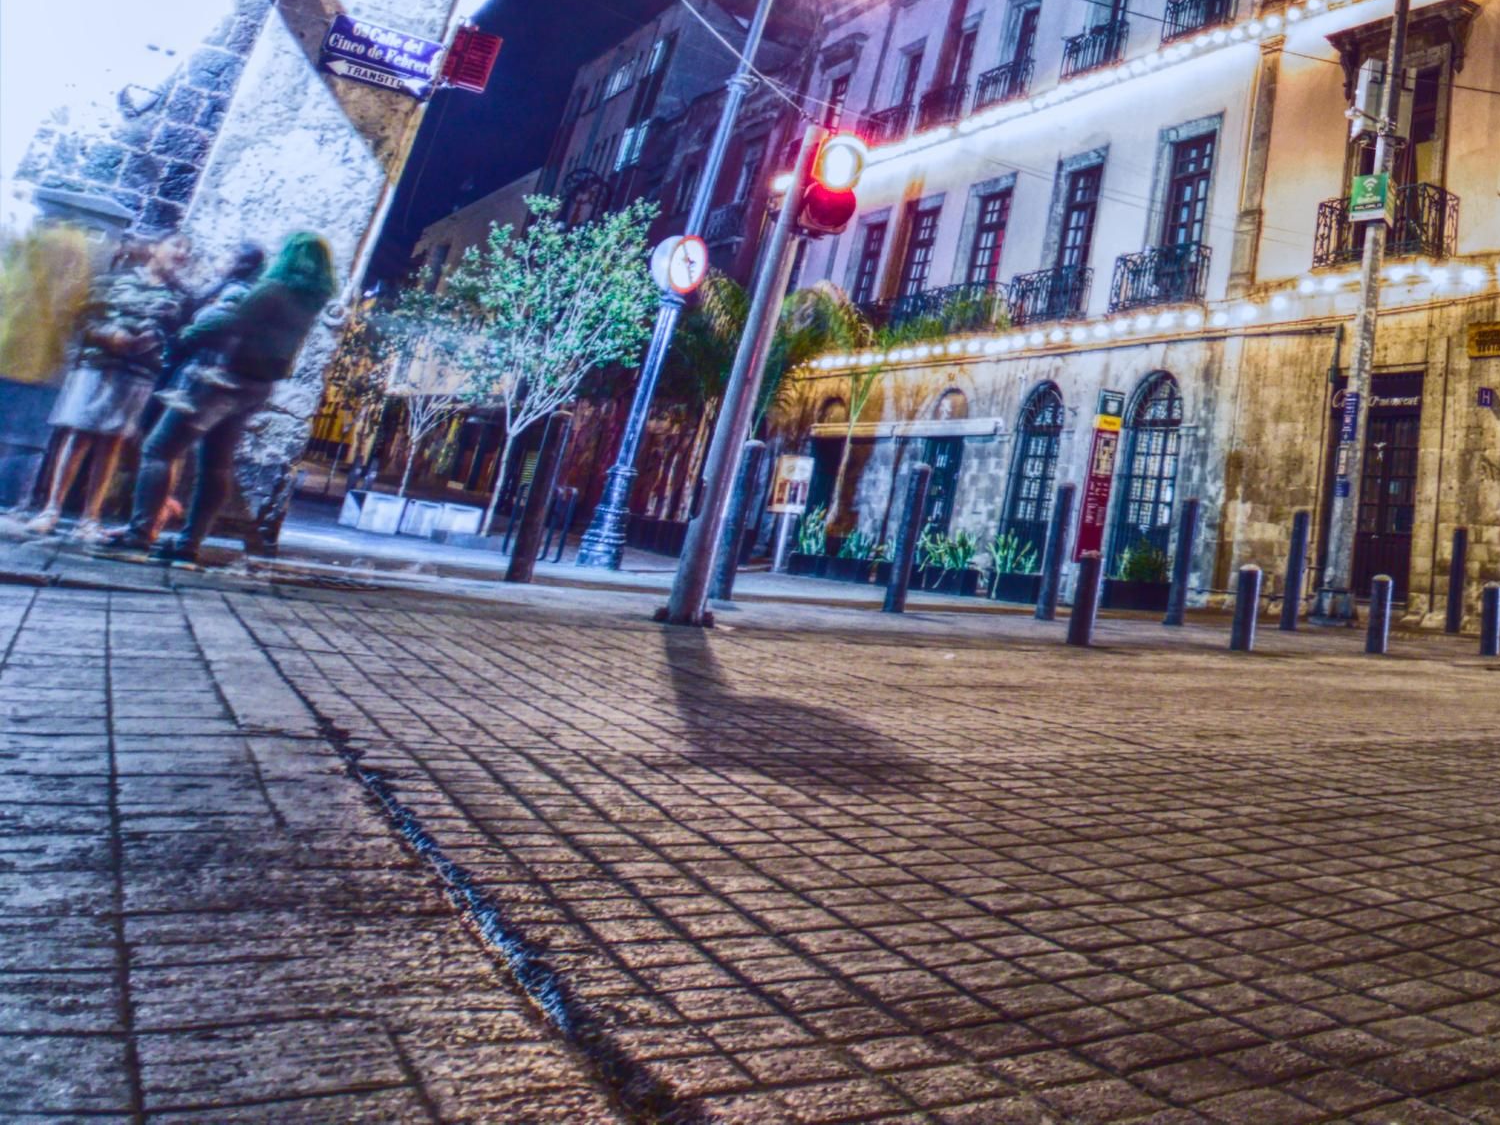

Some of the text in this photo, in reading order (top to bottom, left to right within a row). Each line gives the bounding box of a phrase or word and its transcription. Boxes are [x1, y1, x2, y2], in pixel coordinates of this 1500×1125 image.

[328, 33, 366, 55] Cinco
[367, 45, 384, 60] de
[370, 27, 402, 48] Calle
[403, 39, 424, 54] del
[1482, 391, 1491, 404] H
